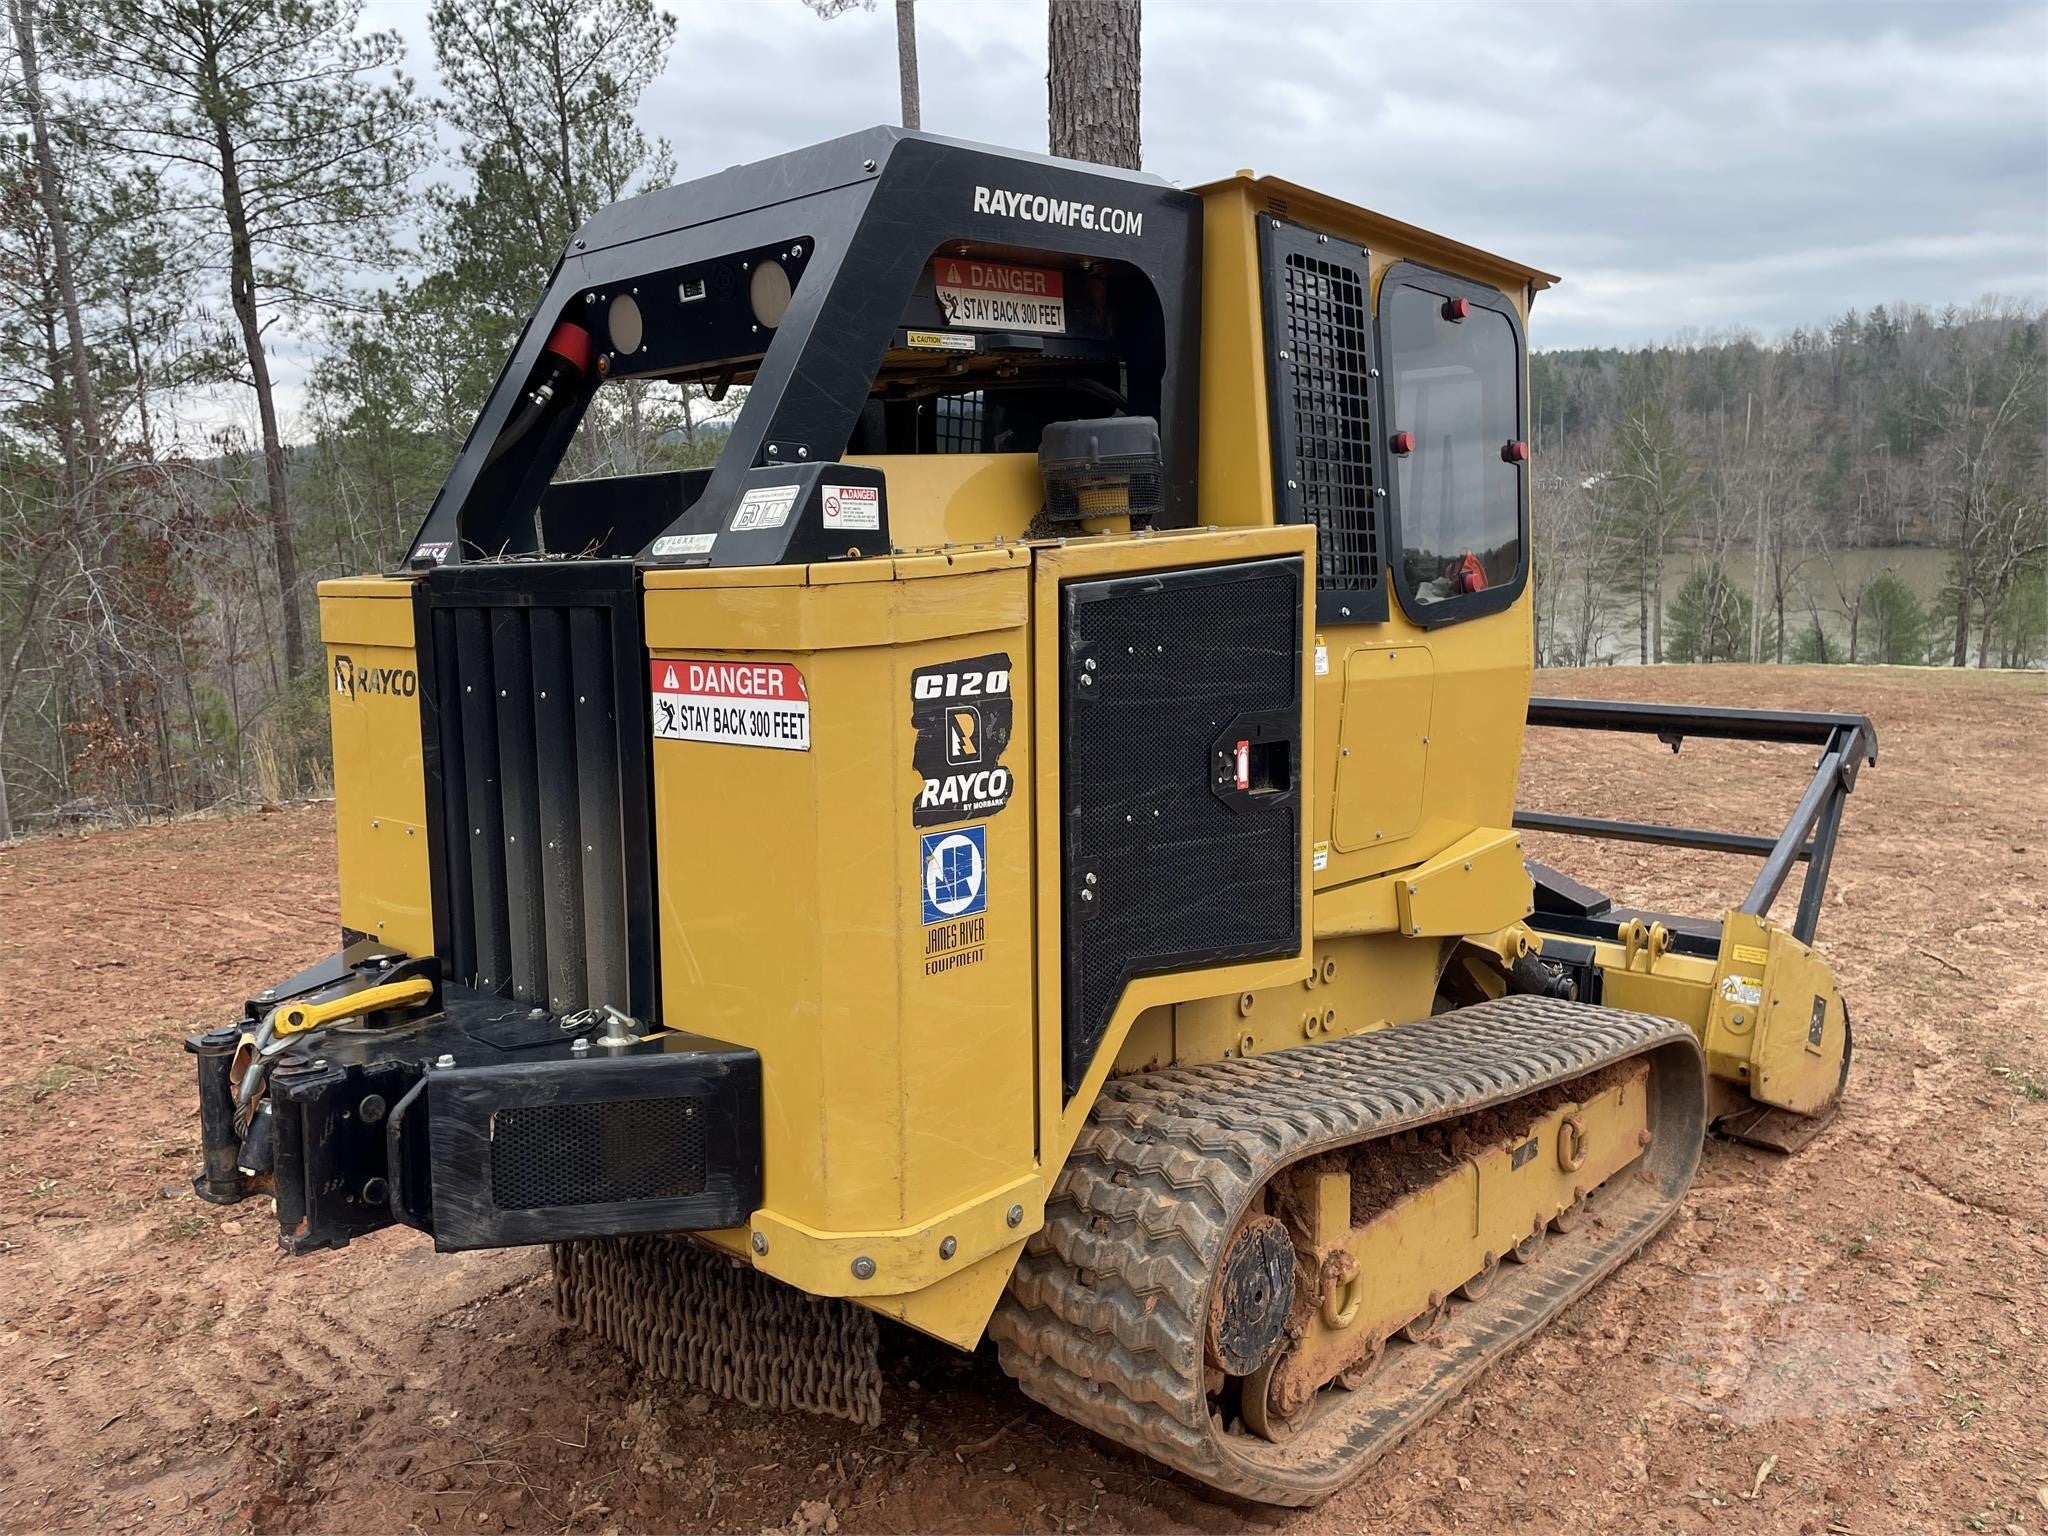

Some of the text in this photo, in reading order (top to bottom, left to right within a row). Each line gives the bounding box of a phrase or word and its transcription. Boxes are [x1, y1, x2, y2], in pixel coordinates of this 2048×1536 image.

[973, 186, 1143, 236] RAYCOMFG.COM
[971, 265, 1046, 294] DANGER
[963, 299, 1061, 326] STAY BACK 300 FEET
[916, 335, 941, 344] CAUTION
[847, 489, 876, 500] DANGER
[357, 667, 417, 697] RAYCO
[689, 665, 784, 697] DANGER
[680, 704, 806, 740] STAY BACK 300 FEET
[920, 768, 1008, 809] RAYCO
[963, 798, 1004, 811] BY MORBARK
[925, 917, 985, 955] JAMES RIVER
[925, 949, 985, 976] EQUIPMENT
